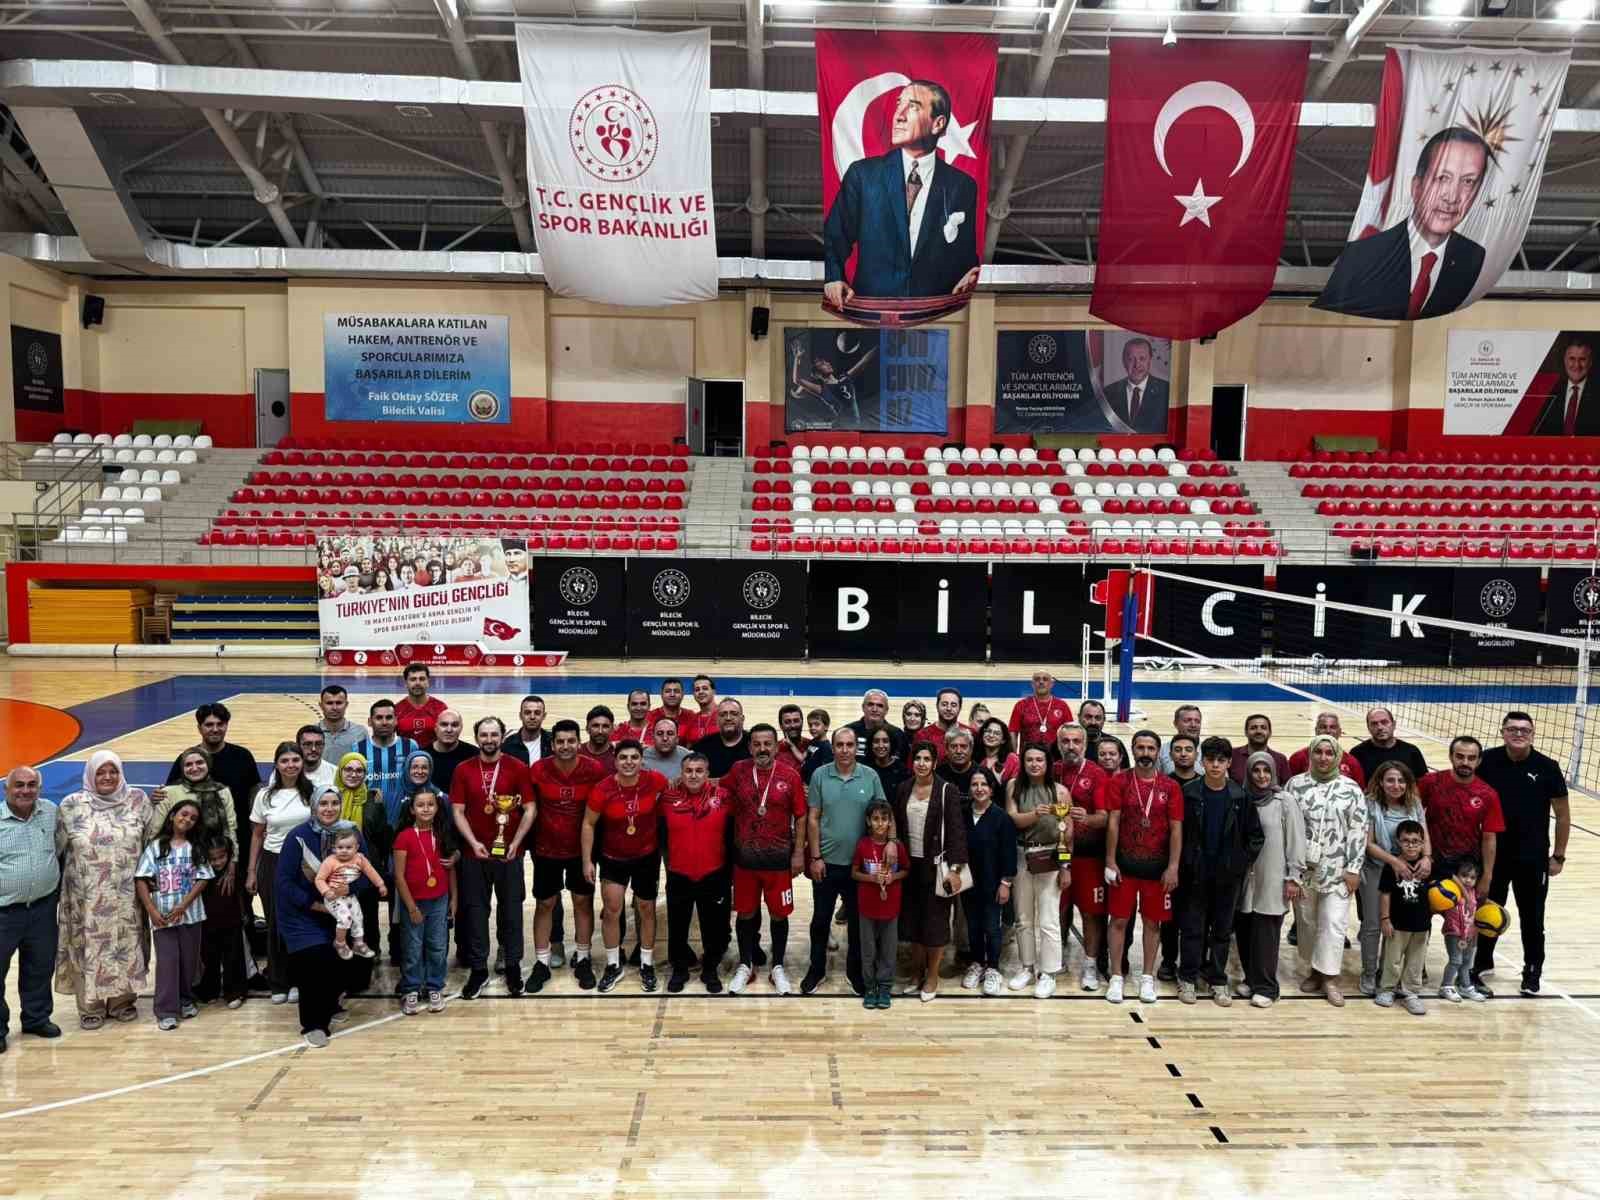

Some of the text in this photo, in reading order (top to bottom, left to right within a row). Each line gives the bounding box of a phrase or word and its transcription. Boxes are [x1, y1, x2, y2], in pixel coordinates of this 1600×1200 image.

[536, 187, 706, 216] T.C. GENÇLİK VE
[539, 213, 708, 239] SPOR BAKANLIĞI
[337, 315, 487, 330] MÜSABAKALARA KATILAN
[348, 333, 477, 347] HAKEM, ANTRENÖR VE
[361, 352, 465, 364] SPORCULARIMIZA
[356, 368, 471, 382] BAŞARILAR DİLERİM
[368, 390, 458, 403] Faik Oktay SÖZER
[382, 406, 445, 416] Bilecik Valisi
[781, 888, 792, 906] 18
[1093, 886, 1104, 903] 13
[1164, 893, 1171, 910] 6
